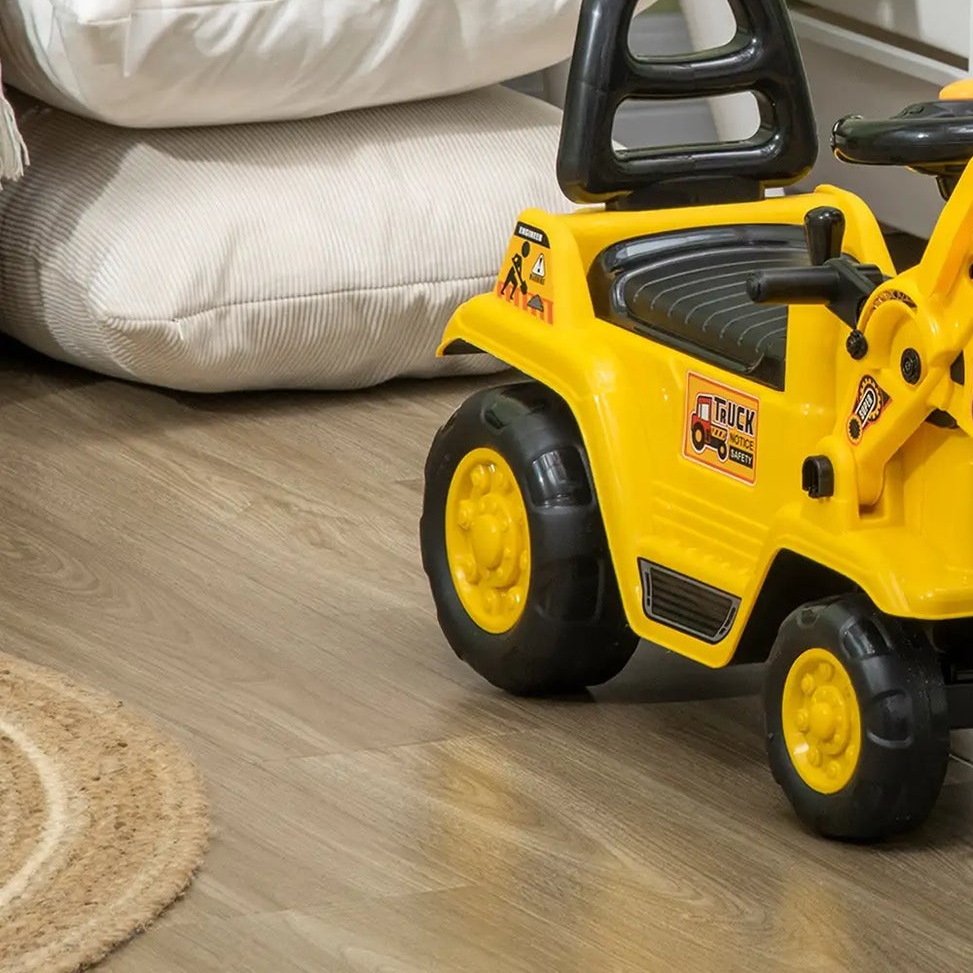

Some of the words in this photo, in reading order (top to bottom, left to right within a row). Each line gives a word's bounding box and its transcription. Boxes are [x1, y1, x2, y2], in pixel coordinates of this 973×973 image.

[714, 395, 756, 436] TRUCK
[730, 432, 754, 451] NOTICE
[730, 448, 753, 465] SAFETY
